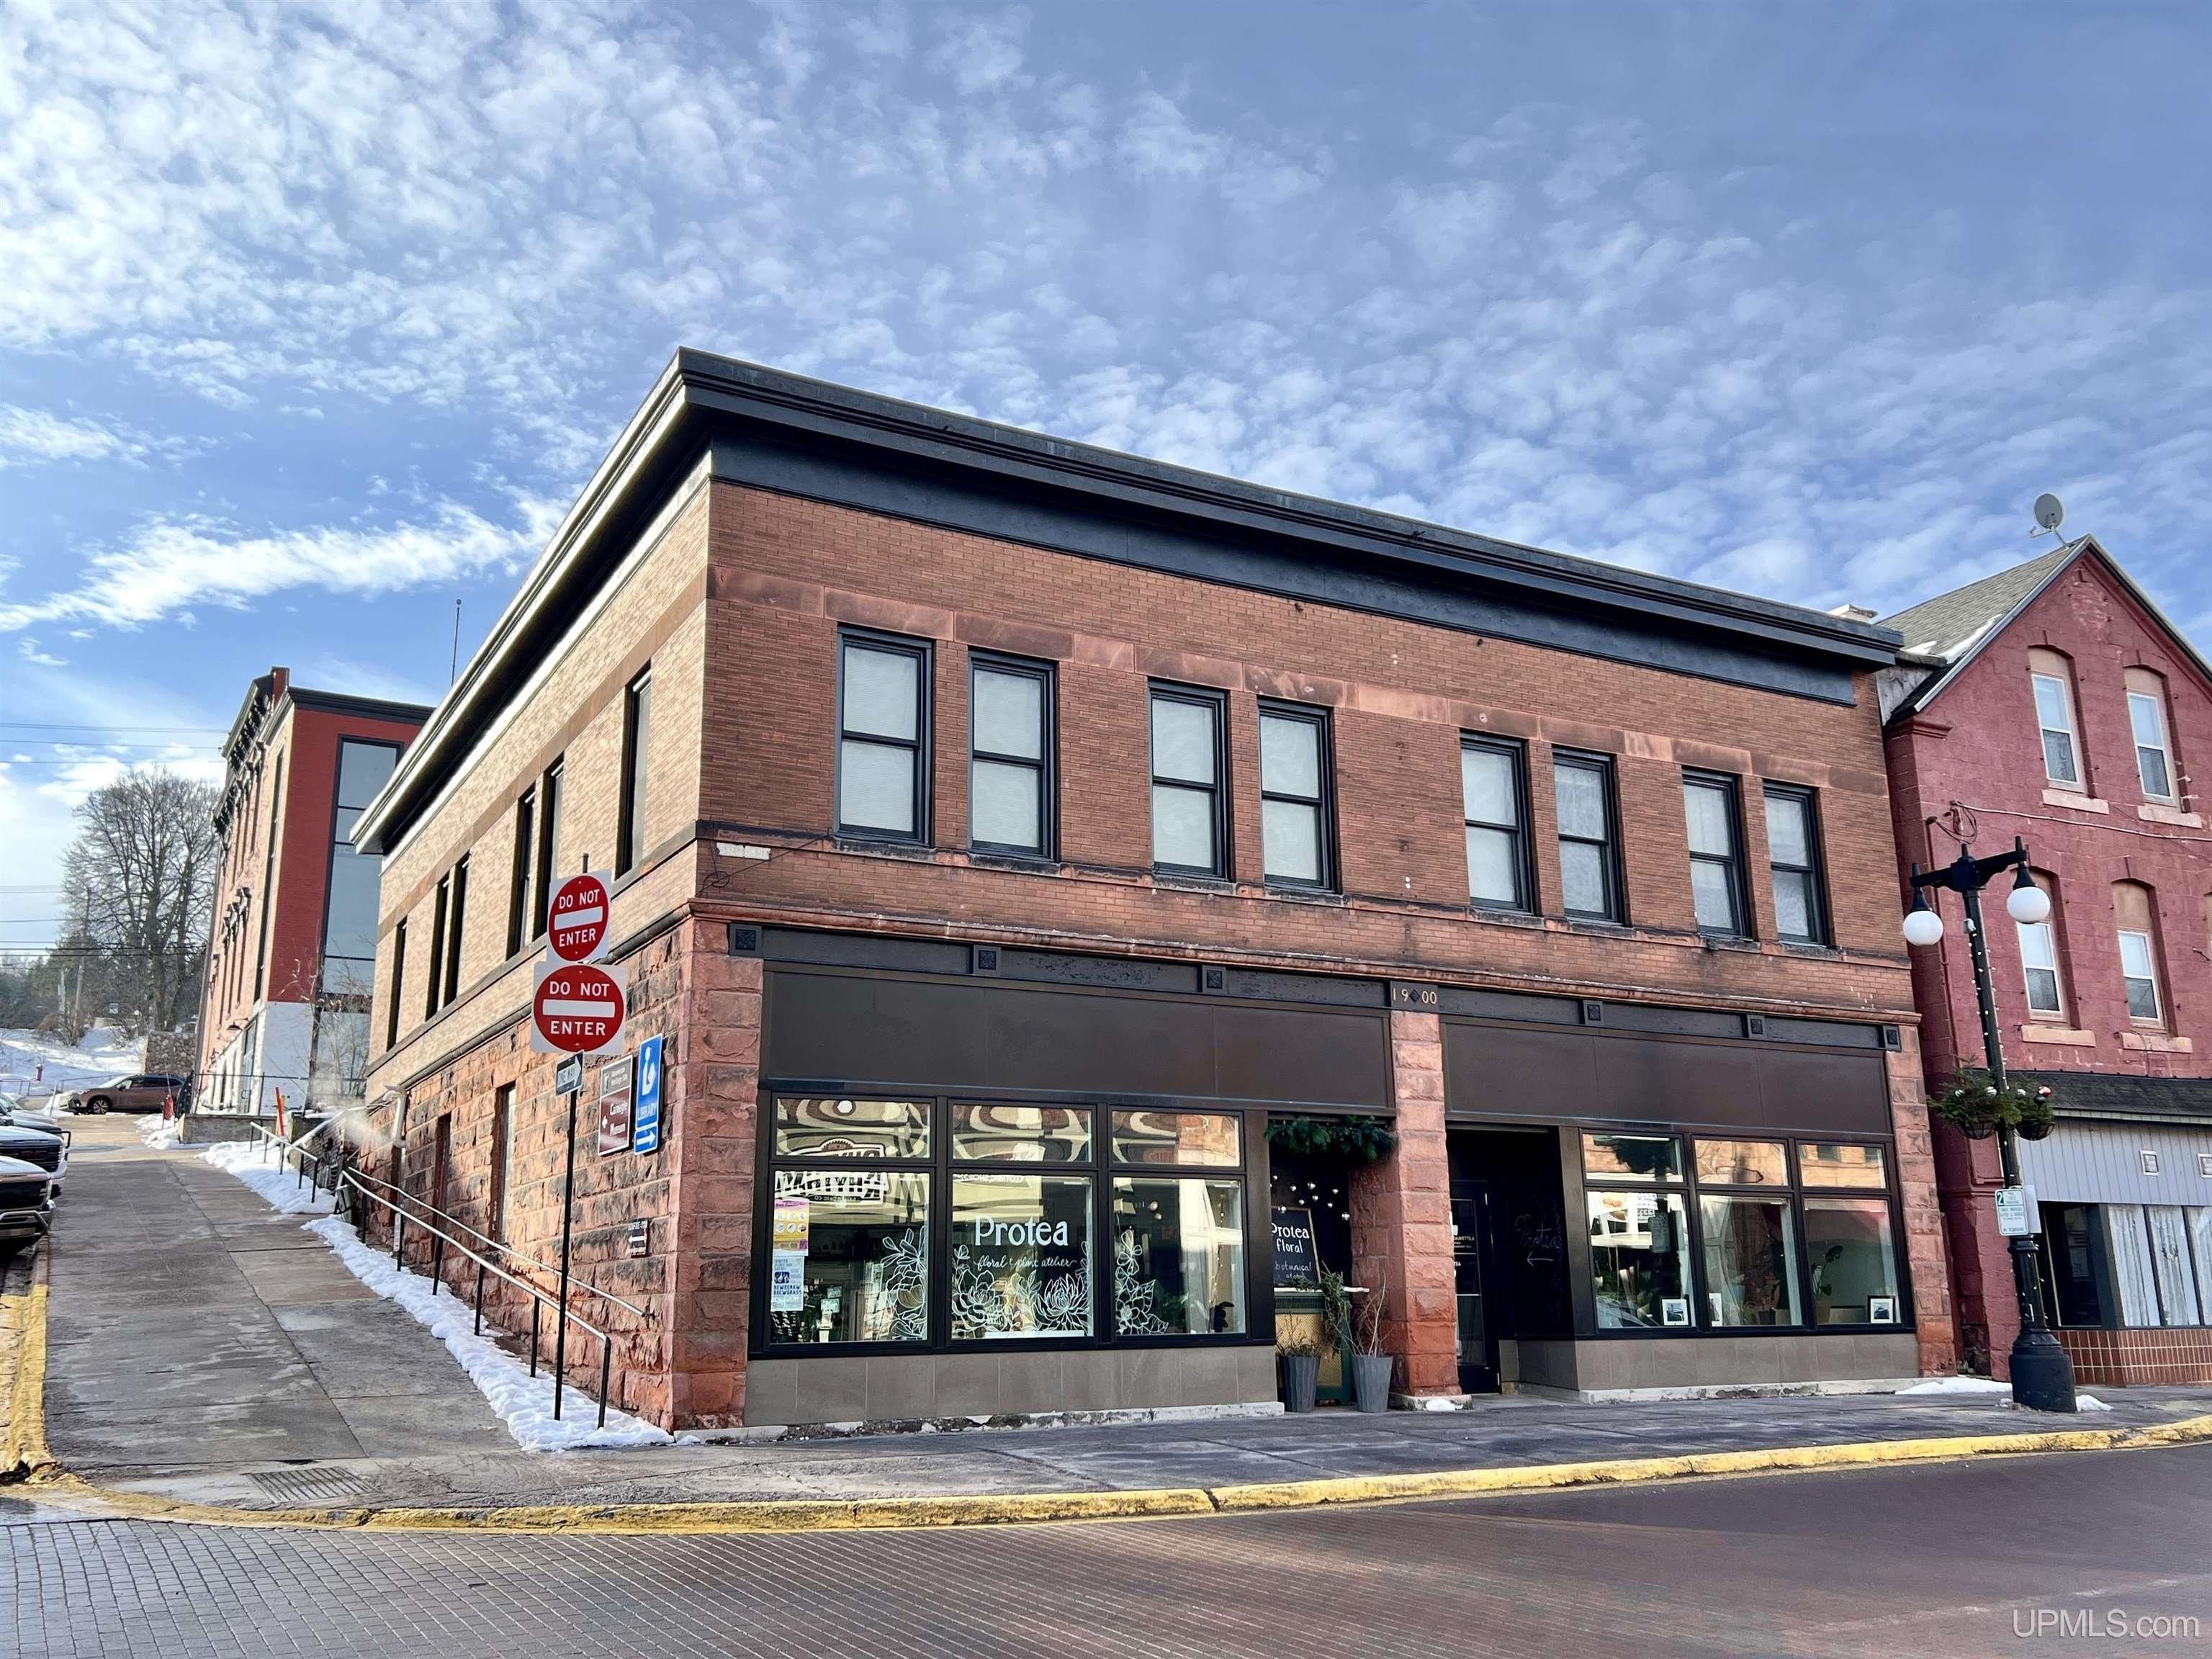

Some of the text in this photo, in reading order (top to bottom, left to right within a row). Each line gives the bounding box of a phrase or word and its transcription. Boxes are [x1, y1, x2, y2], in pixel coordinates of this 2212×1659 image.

[559, 889, 600, 909] DO NOT
[559, 928, 597, 947] ENTER
[549, 981, 610, 997] DO NOT
[550, 1020, 606, 1036] ENTER
[975, 1215, 1069, 1246] Protea
[974, 1255, 1007, 1271] floral
[1041, 1256, 1077, 1267] atelier
[1274, 1260, 1312, 1272] botanical
